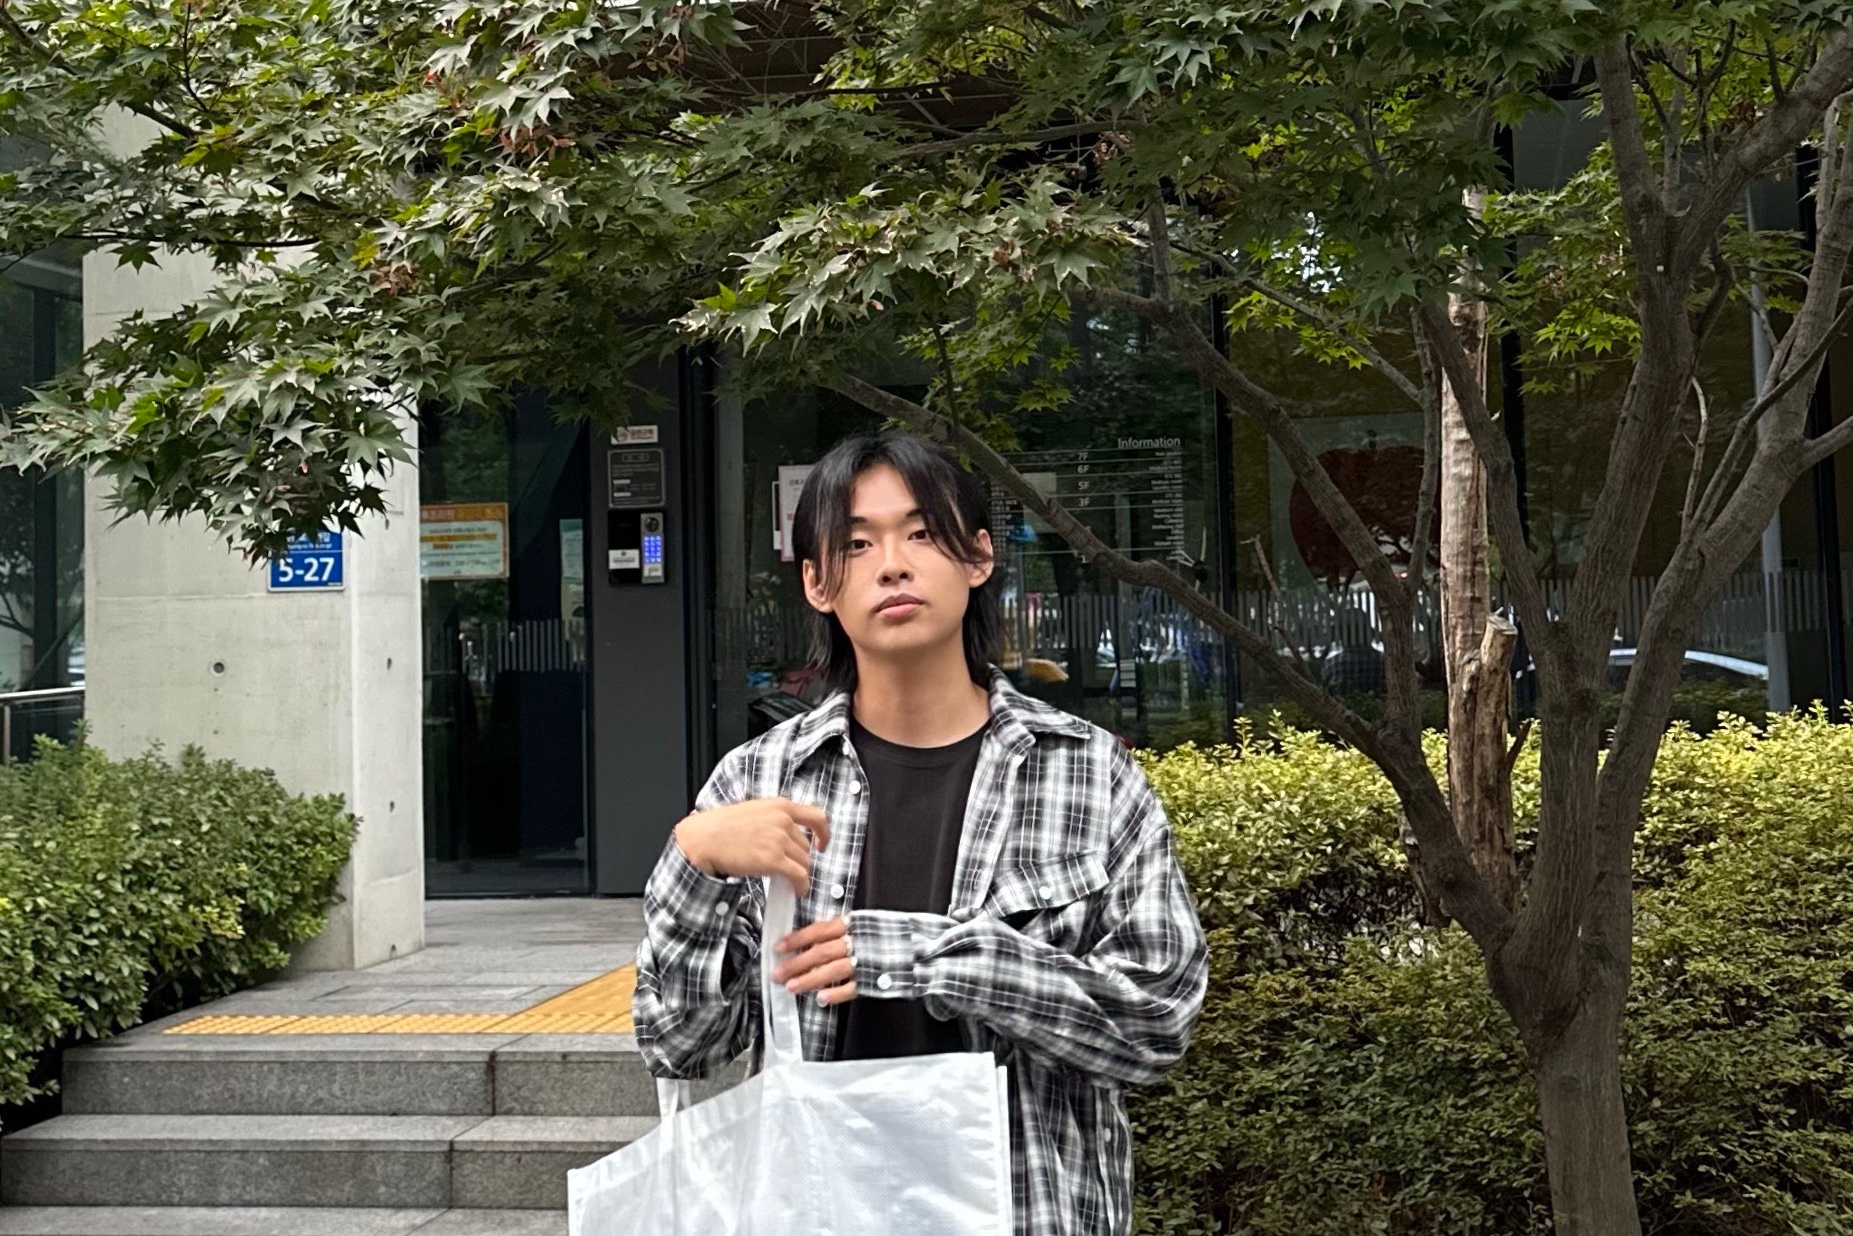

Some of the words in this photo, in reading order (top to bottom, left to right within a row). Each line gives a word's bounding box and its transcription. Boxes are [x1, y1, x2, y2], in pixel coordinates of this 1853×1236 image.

[1117, 437, 1181, 449] Information
[1077, 464, 1090, 473] 6F
[1078, 481, 1090, 490] 5F
[1079, 498, 1090, 507] 3F
[278, 557, 335, 582] 5-27
